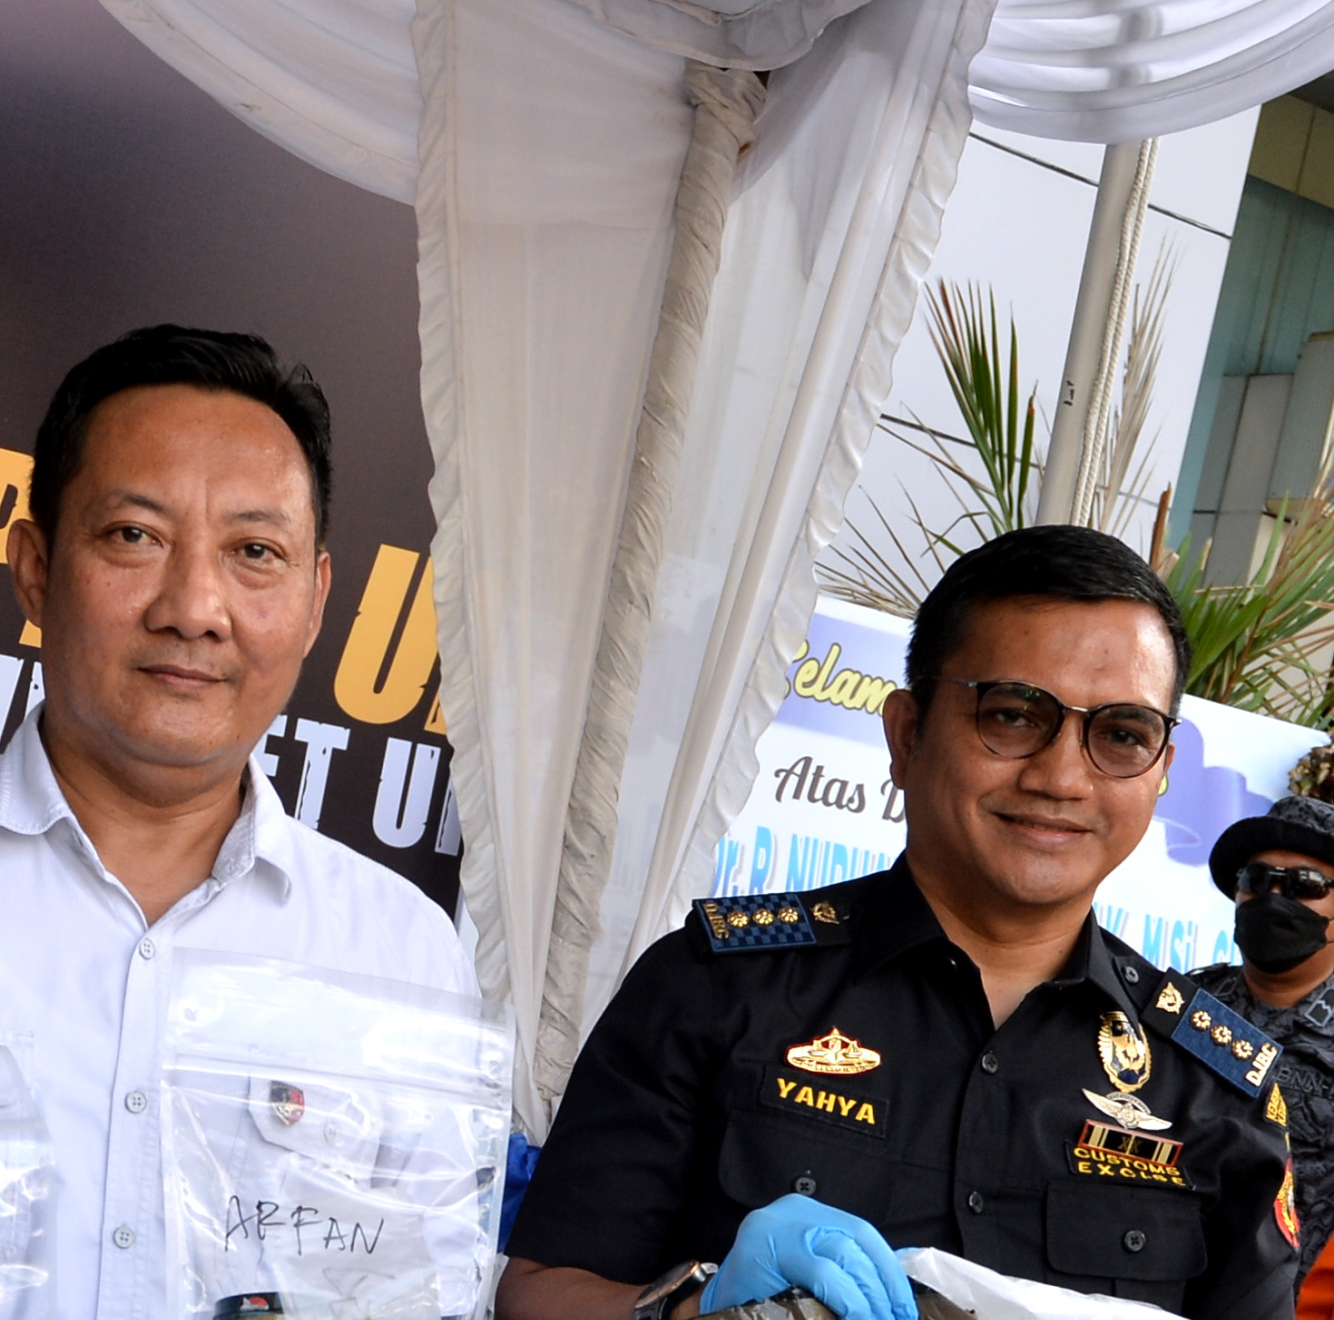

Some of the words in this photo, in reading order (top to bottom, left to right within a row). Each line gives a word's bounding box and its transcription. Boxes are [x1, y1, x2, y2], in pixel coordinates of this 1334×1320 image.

[774, 756, 866, 814] Atas
[1245, 1042, 1279, 1087] DJBC
[777, 1078, 876, 1125] YAHYA
[1073, 1147, 1181, 1177] CUSTOMS
